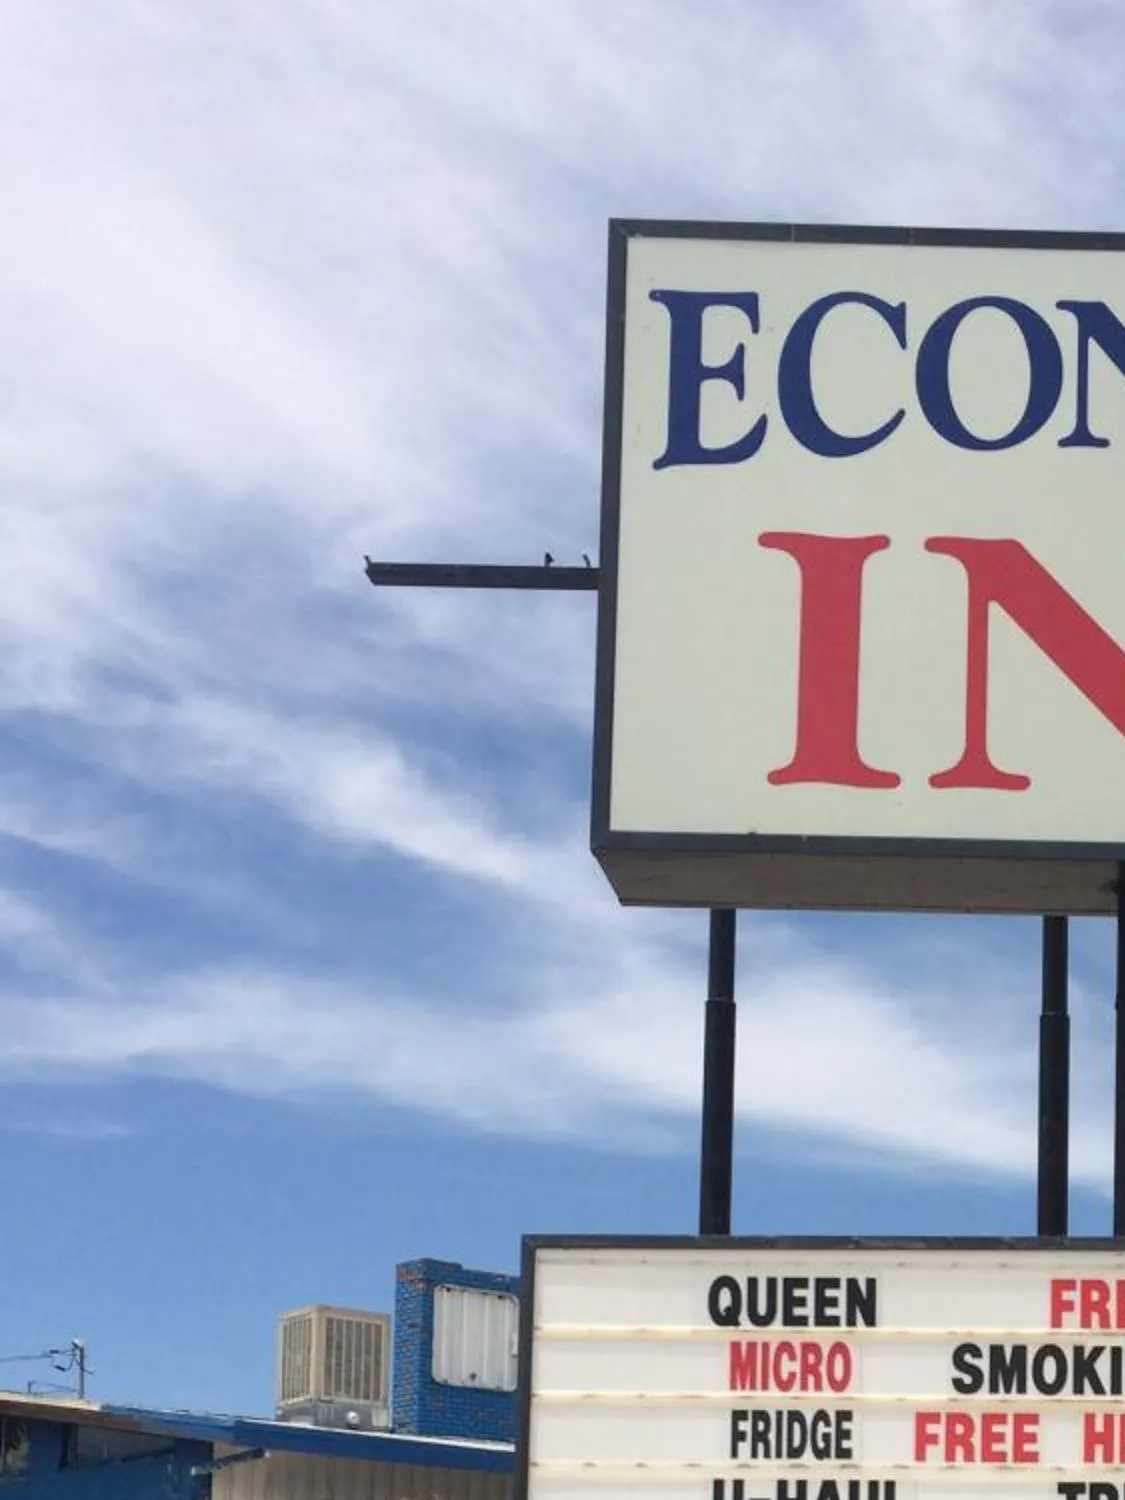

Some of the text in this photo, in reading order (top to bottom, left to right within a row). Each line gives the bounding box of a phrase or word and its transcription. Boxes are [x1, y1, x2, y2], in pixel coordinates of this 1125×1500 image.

[707, 1274, 877, 1328] QUEEN
[730, 1340, 852, 1393] MICRO
[730, 1408, 854, 1461] FRIDGE
[914, 1411, 1041, 1464] FREE
